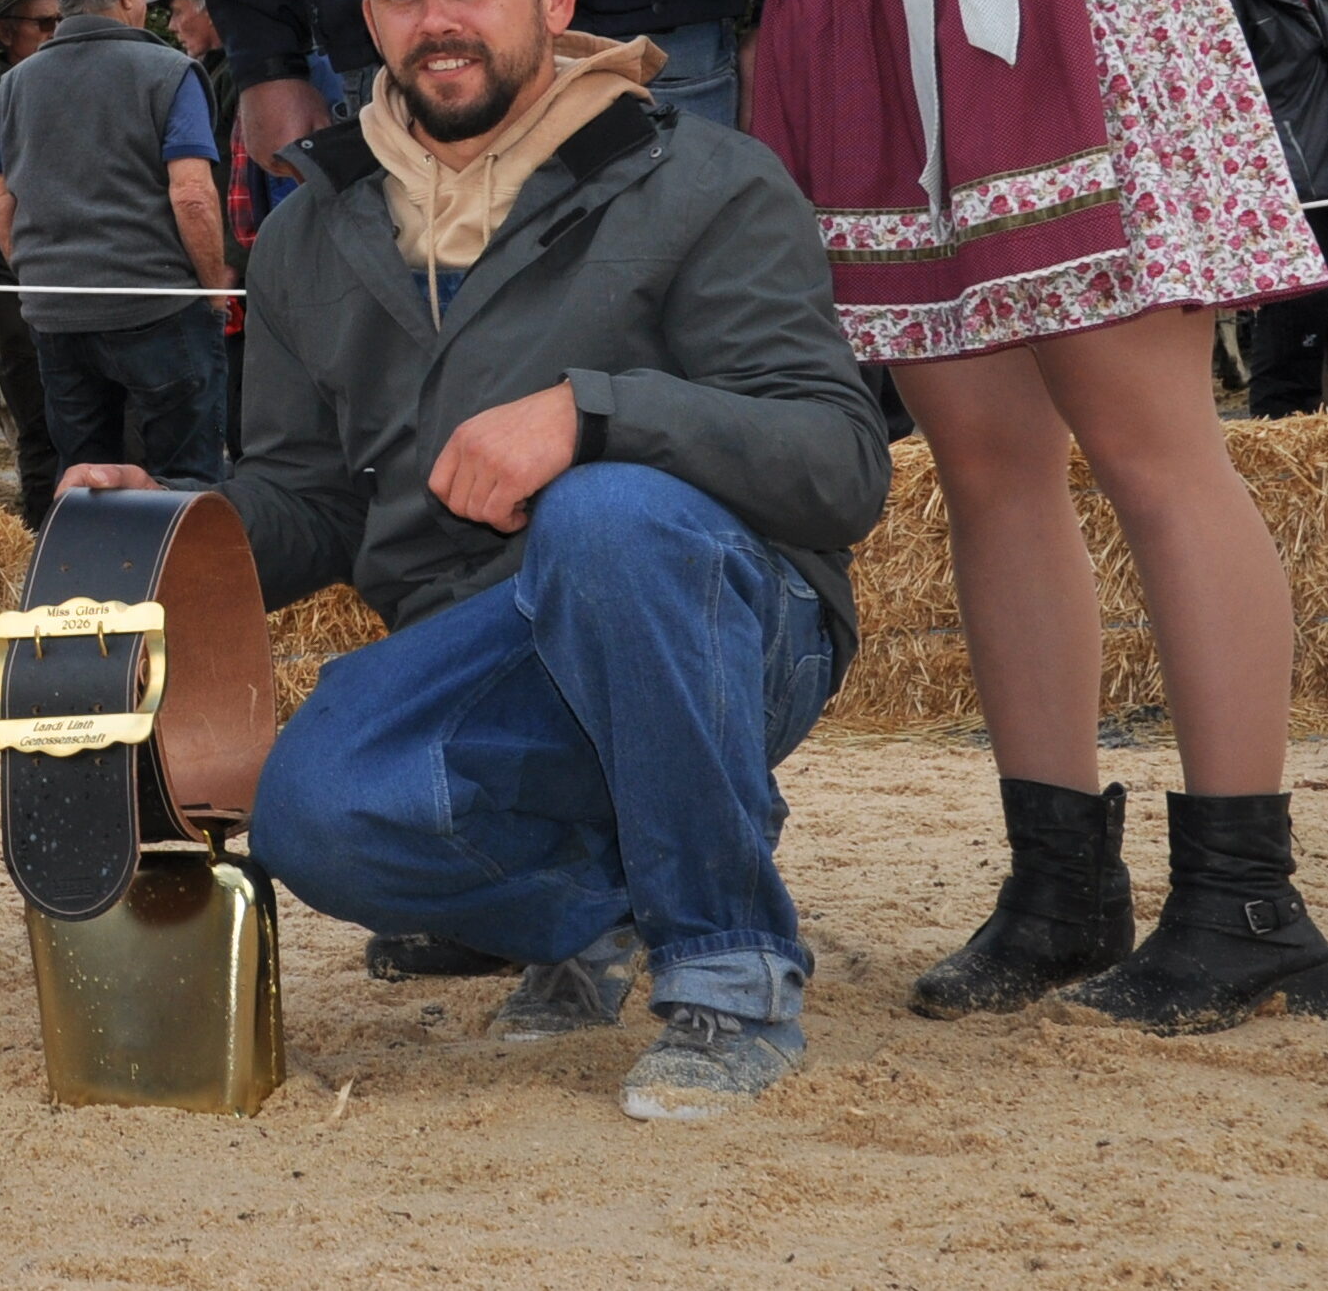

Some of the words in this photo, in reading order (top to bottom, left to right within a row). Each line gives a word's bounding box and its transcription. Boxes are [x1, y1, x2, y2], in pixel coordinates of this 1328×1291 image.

[47, 607, 70, 617] Miss
[61, 619, 91, 630] 2026
[33, 721, 64, 732] Landi
[20, 733, 106, 747] Genossenschaft
